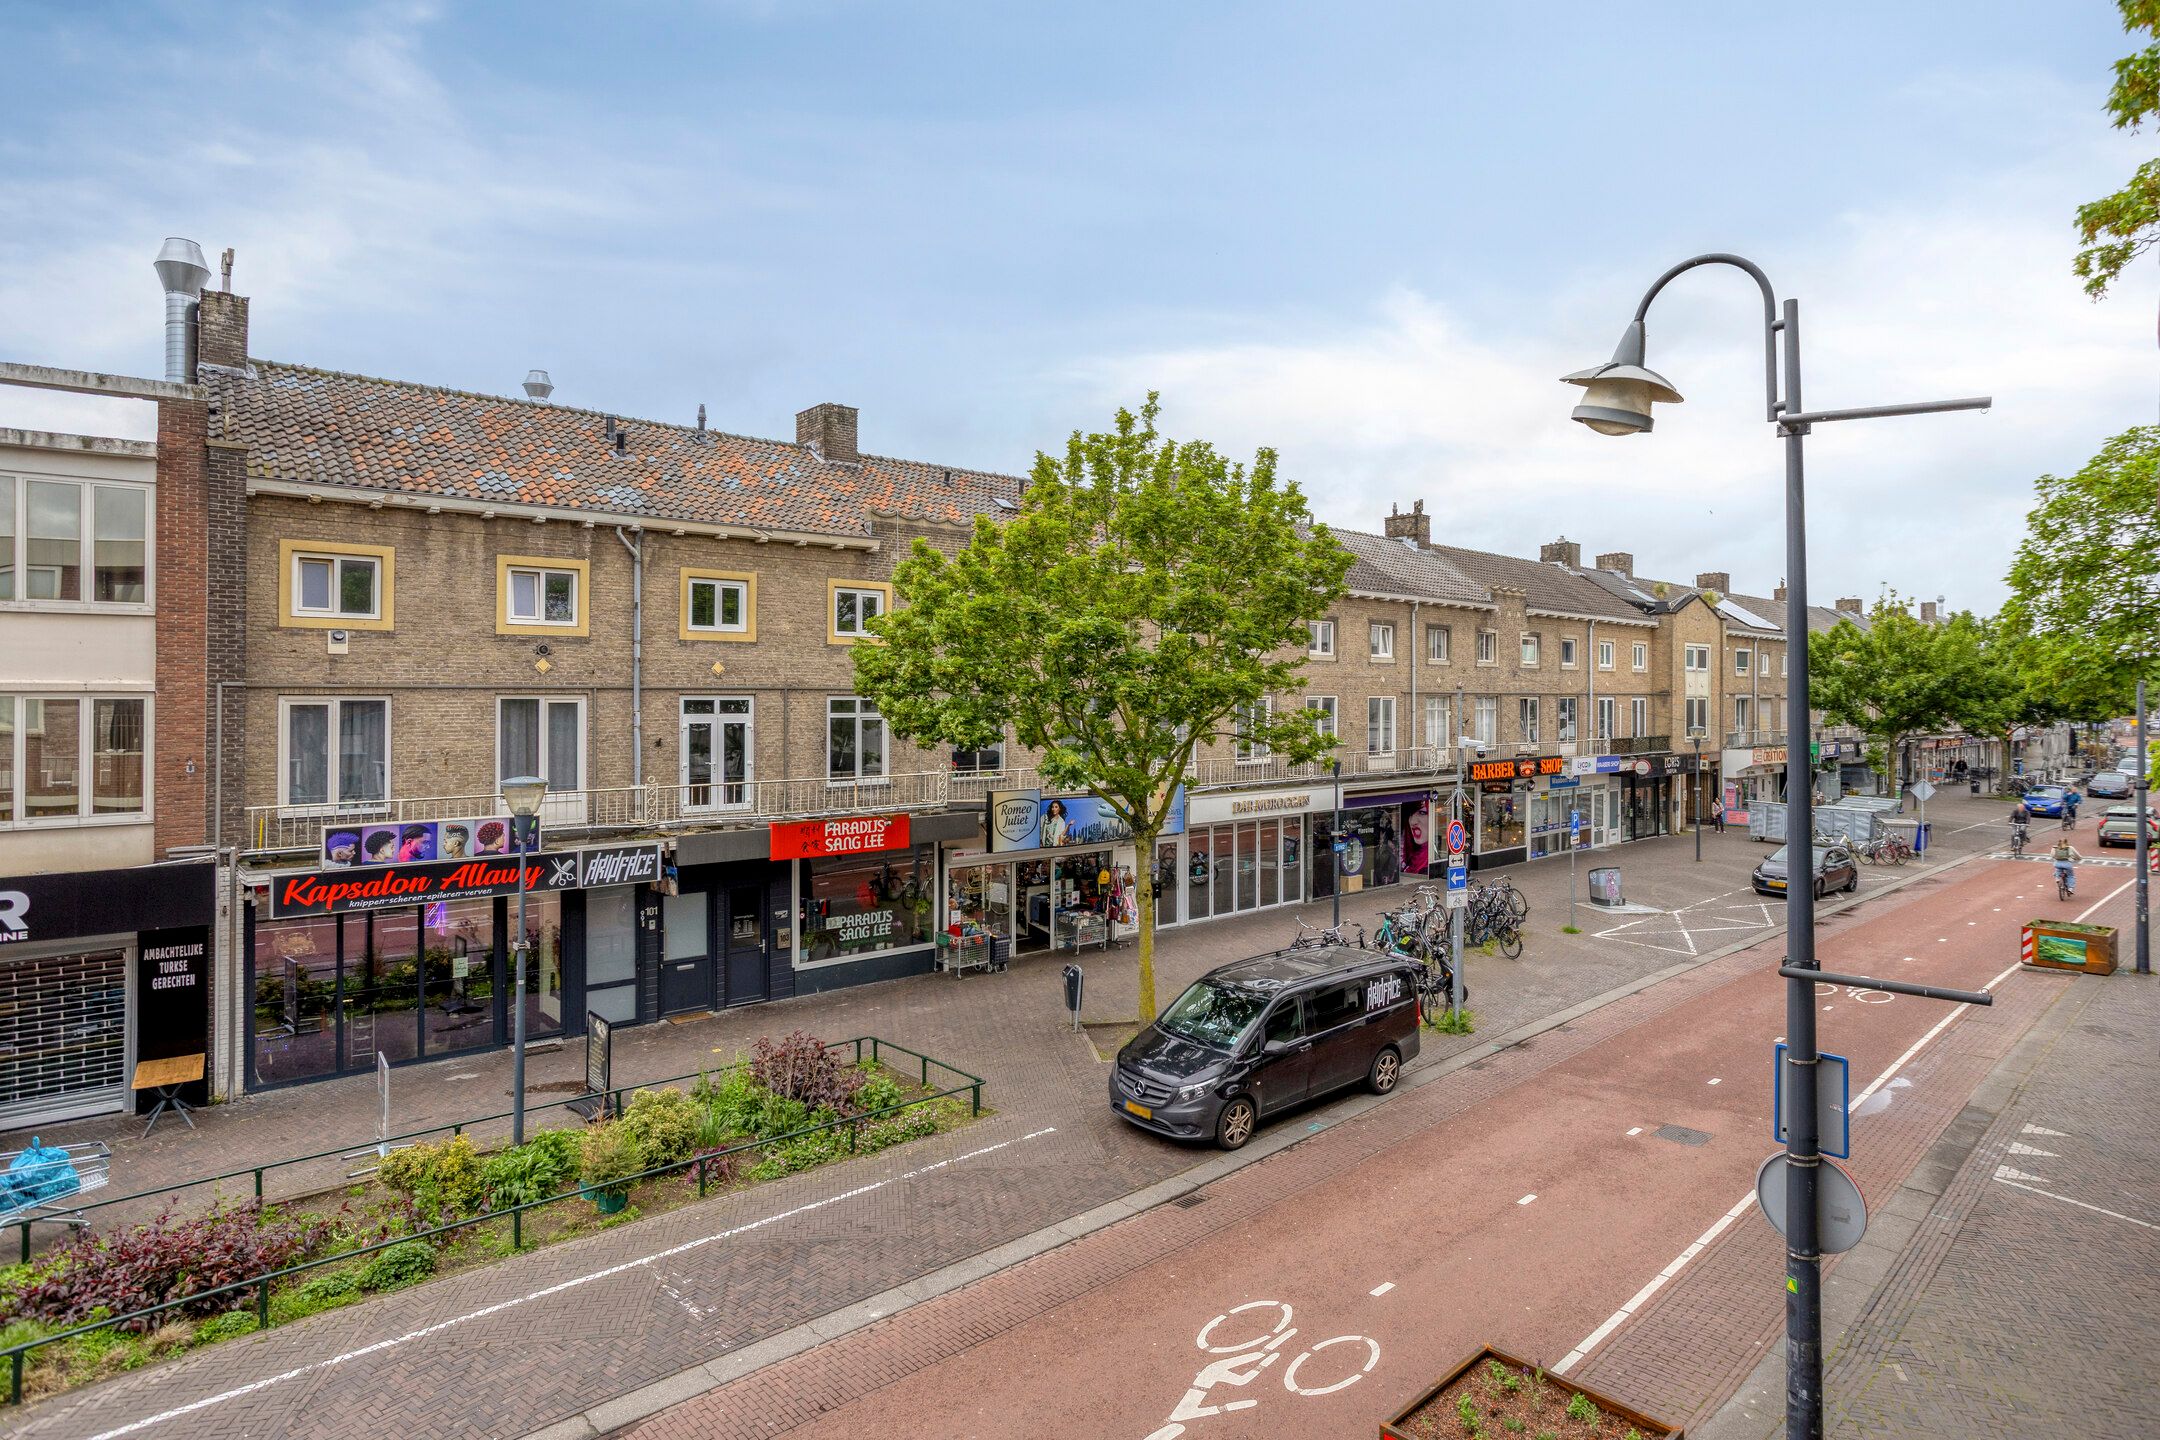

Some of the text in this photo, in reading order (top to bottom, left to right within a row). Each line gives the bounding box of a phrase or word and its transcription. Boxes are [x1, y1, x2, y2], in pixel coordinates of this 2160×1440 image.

[1473, 758, 1562, 780] BARBER SHOP
[1001, 804, 1032, 816] Romeo
[1003, 814, 1029, 829] Juliet
[825, 834, 885, 852] SANG LEE
[283, 871, 433, 910] Kapsalon
[349, 888, 493, 908] knippen-scheren-epileren-verven
[645, 906, 658, 916] 101
[840, 910, 893, 927] PARADIJS
[839, 923, 892, 941] SANG LEE
[144, 943, 203, 960] AMBACHTELIJKE
[159, 960, 188, 974] TURKSE
[152, 974, 196, 990] GERECHTEN
